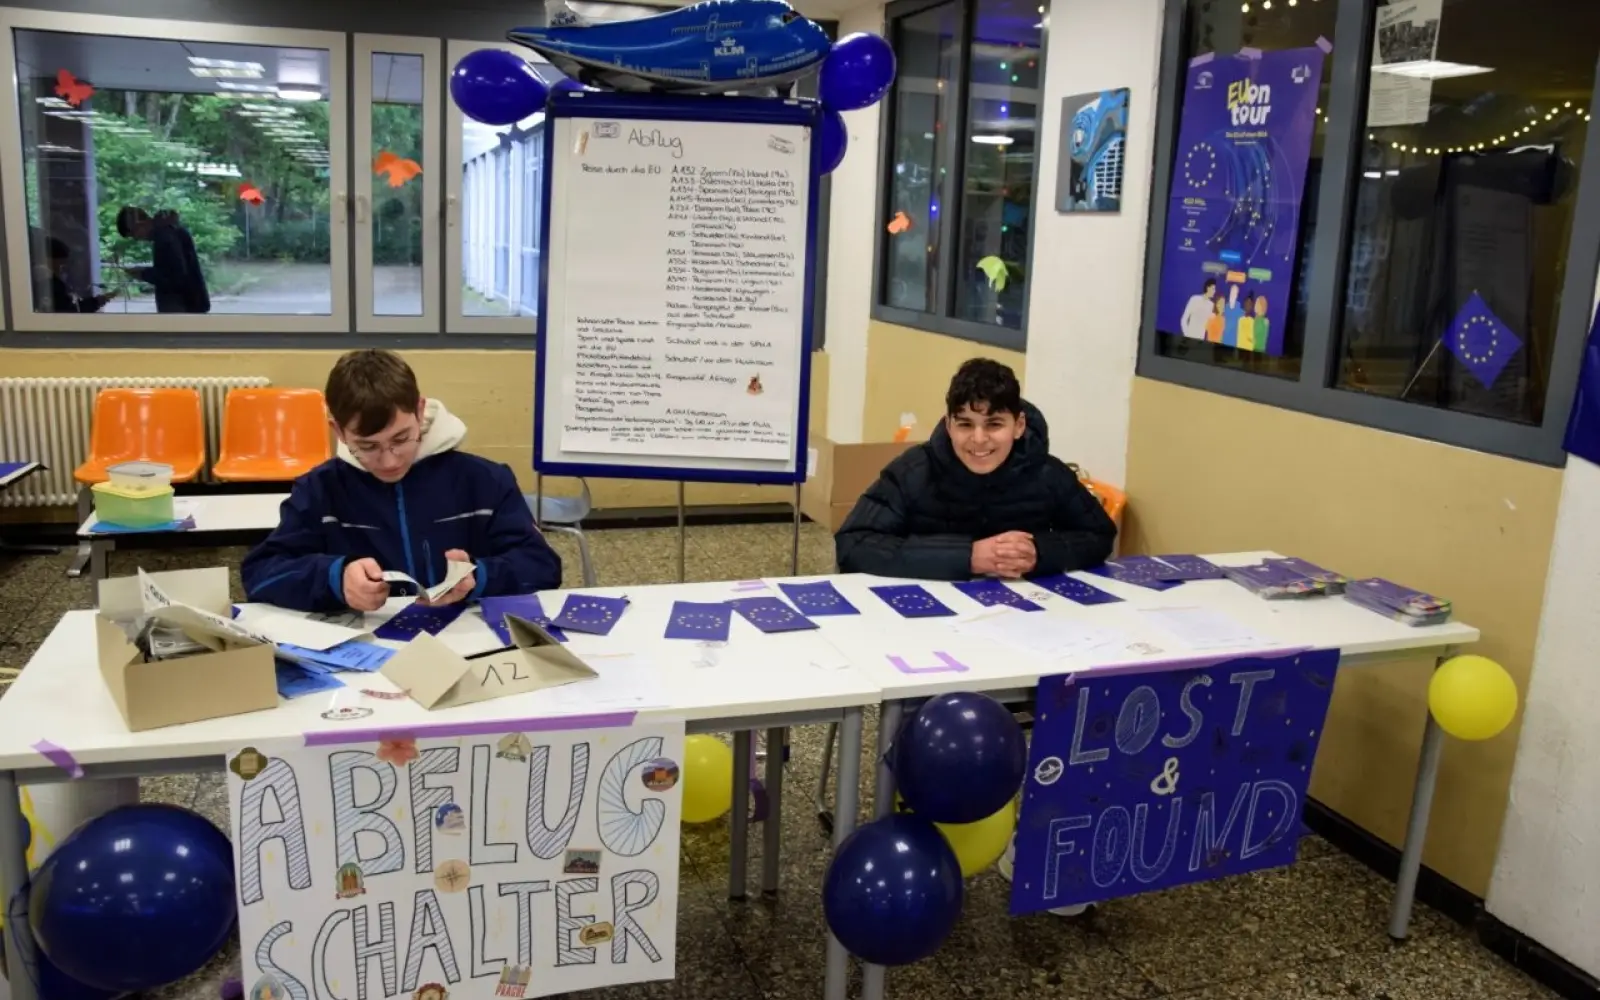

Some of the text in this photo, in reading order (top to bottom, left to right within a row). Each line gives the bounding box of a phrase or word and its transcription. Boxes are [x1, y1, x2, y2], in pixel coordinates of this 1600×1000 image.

[714, 46, 745, 57] KLM
[1249, 84, 1271, 104] on
[1231, 105, 1271, 126] tour
[628, 128, 684, 158] Abflug
[648, 165, 661, 174] EU
[1069, 668, 1275, 765] LOST
[1150, 757, 1180, 795] &
[239, 737, 666, 906] ABFLUG
[1043, 780, 1298, 900] FOUND
[255, 869, 663, 1000] SCHALTER
